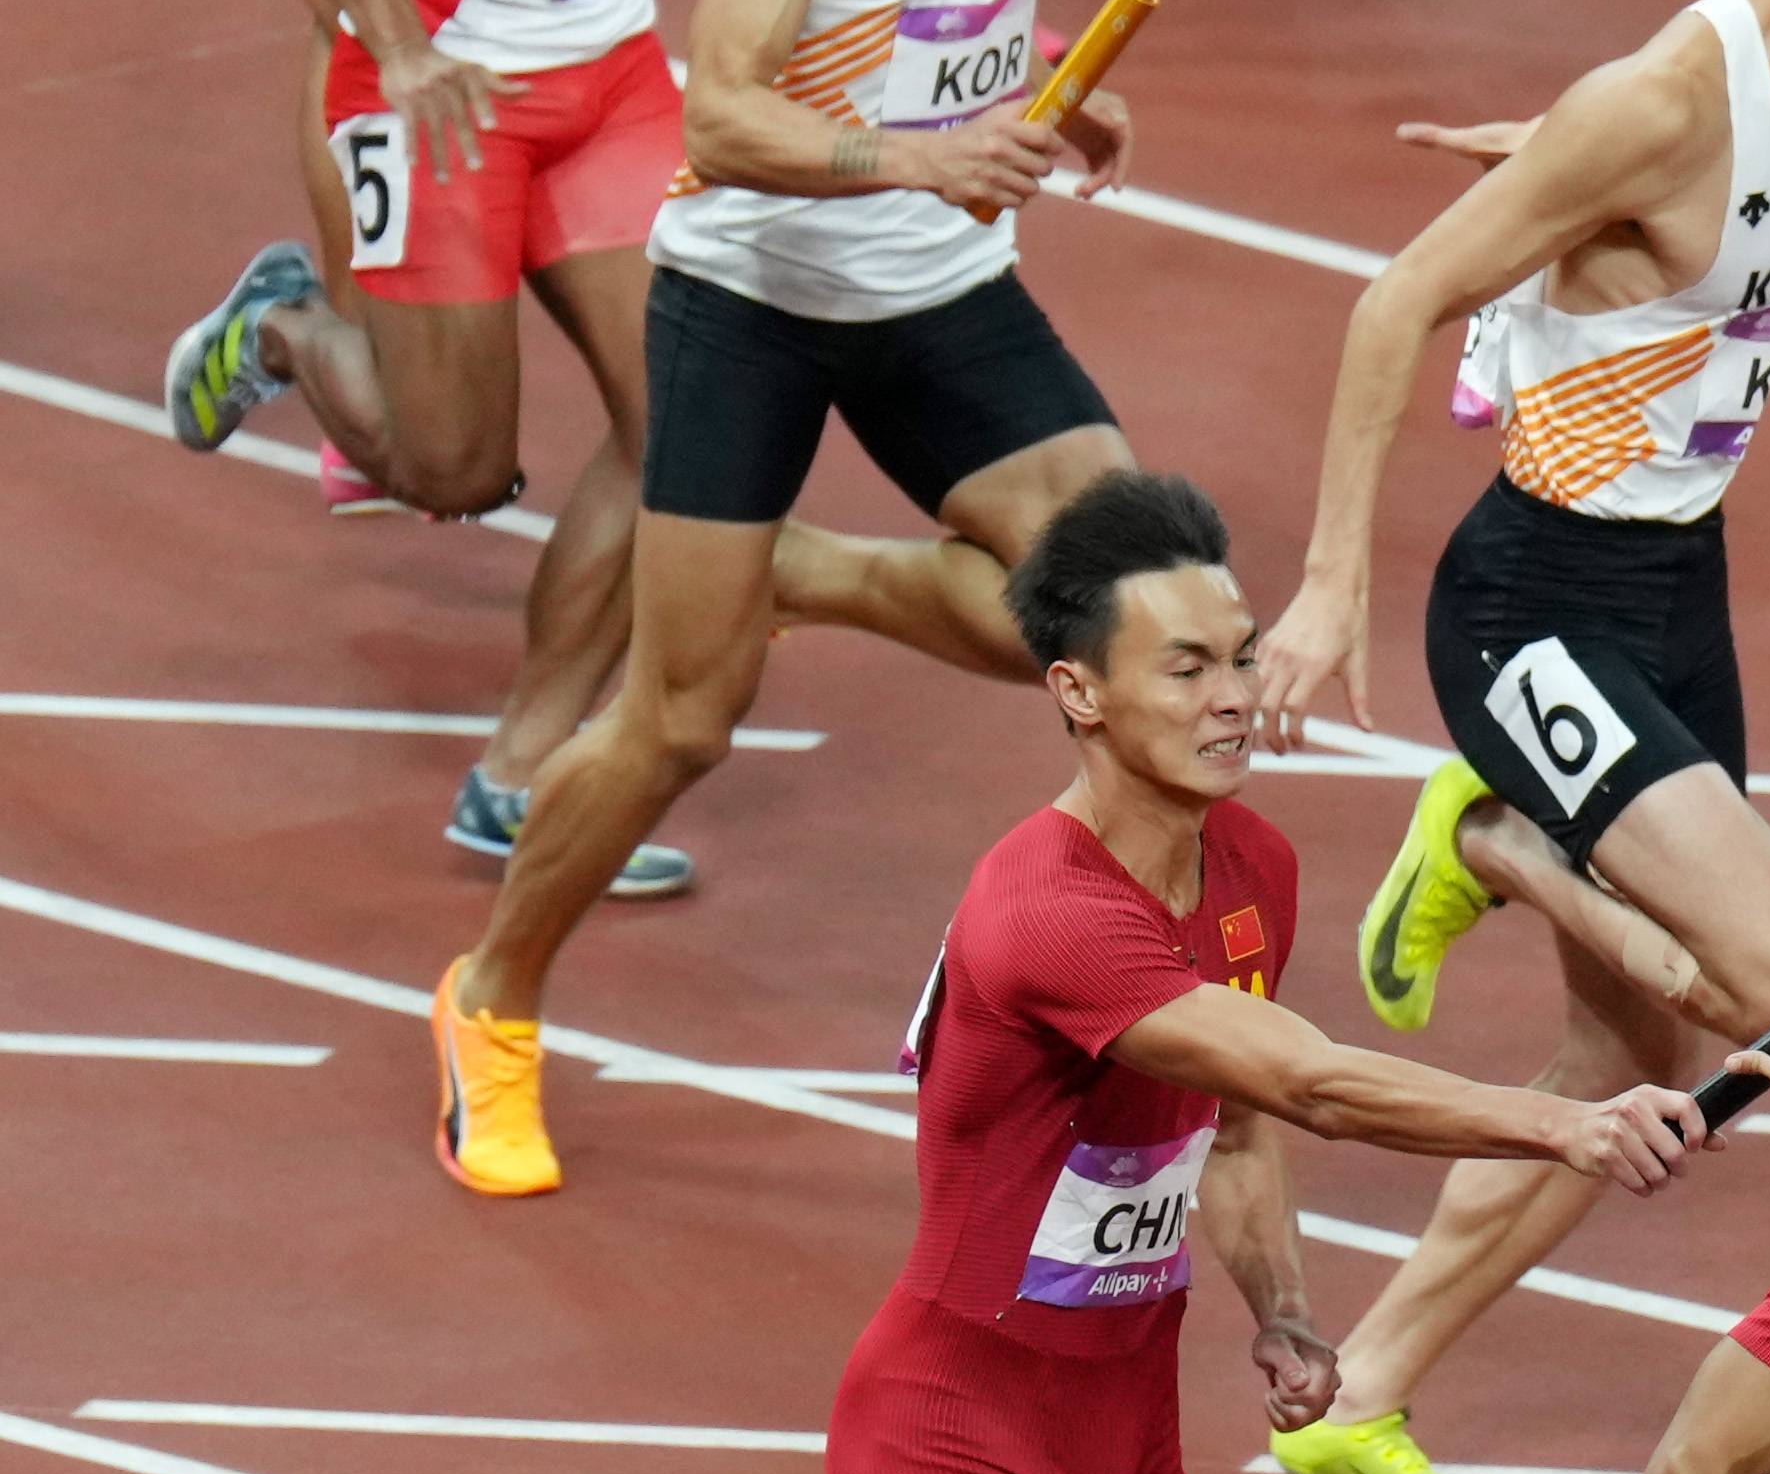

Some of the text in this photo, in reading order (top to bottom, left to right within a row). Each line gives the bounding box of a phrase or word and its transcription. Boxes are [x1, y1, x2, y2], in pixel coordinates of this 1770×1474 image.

[931, 33, 1024, 107] KOR
[350, 134, 389, 244] 5
[1518, 668, 1598, 776] 6
